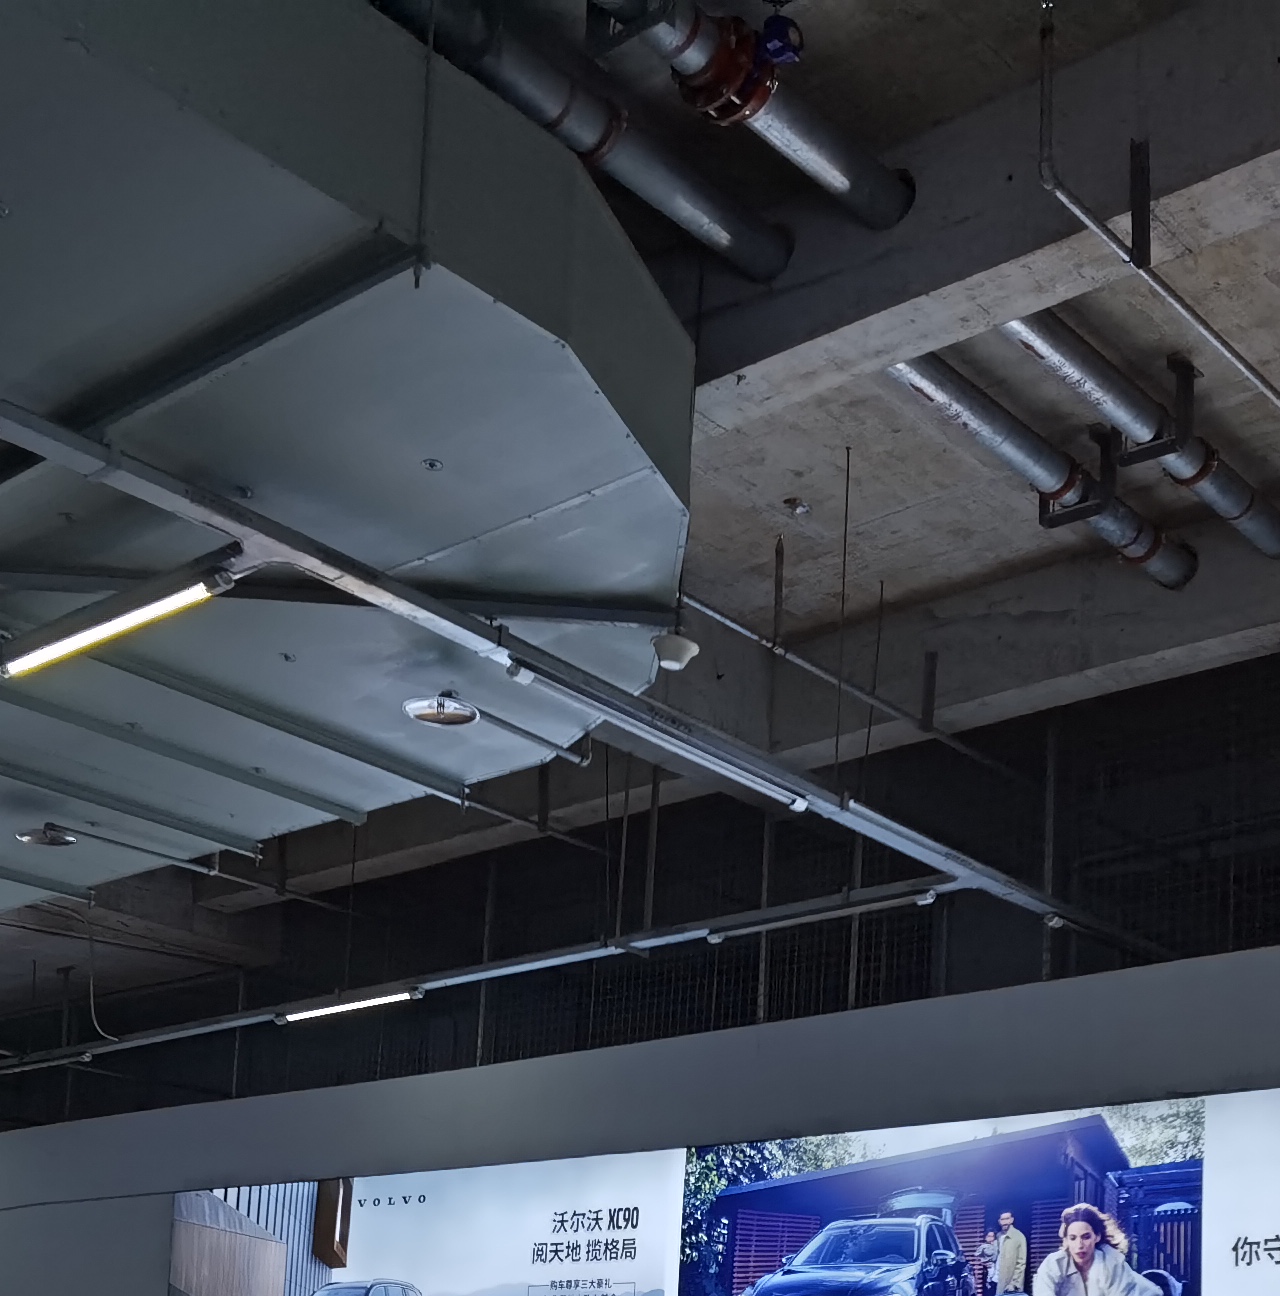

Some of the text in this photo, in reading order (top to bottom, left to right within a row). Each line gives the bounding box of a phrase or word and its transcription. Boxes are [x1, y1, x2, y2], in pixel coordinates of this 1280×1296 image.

[357, 1194, 426, 1208] VOLVO
[552, 1206, 639, 1233] 沃尔沃 XC90
[532, 1238, 637, 1264] 阅天地 揽格局
